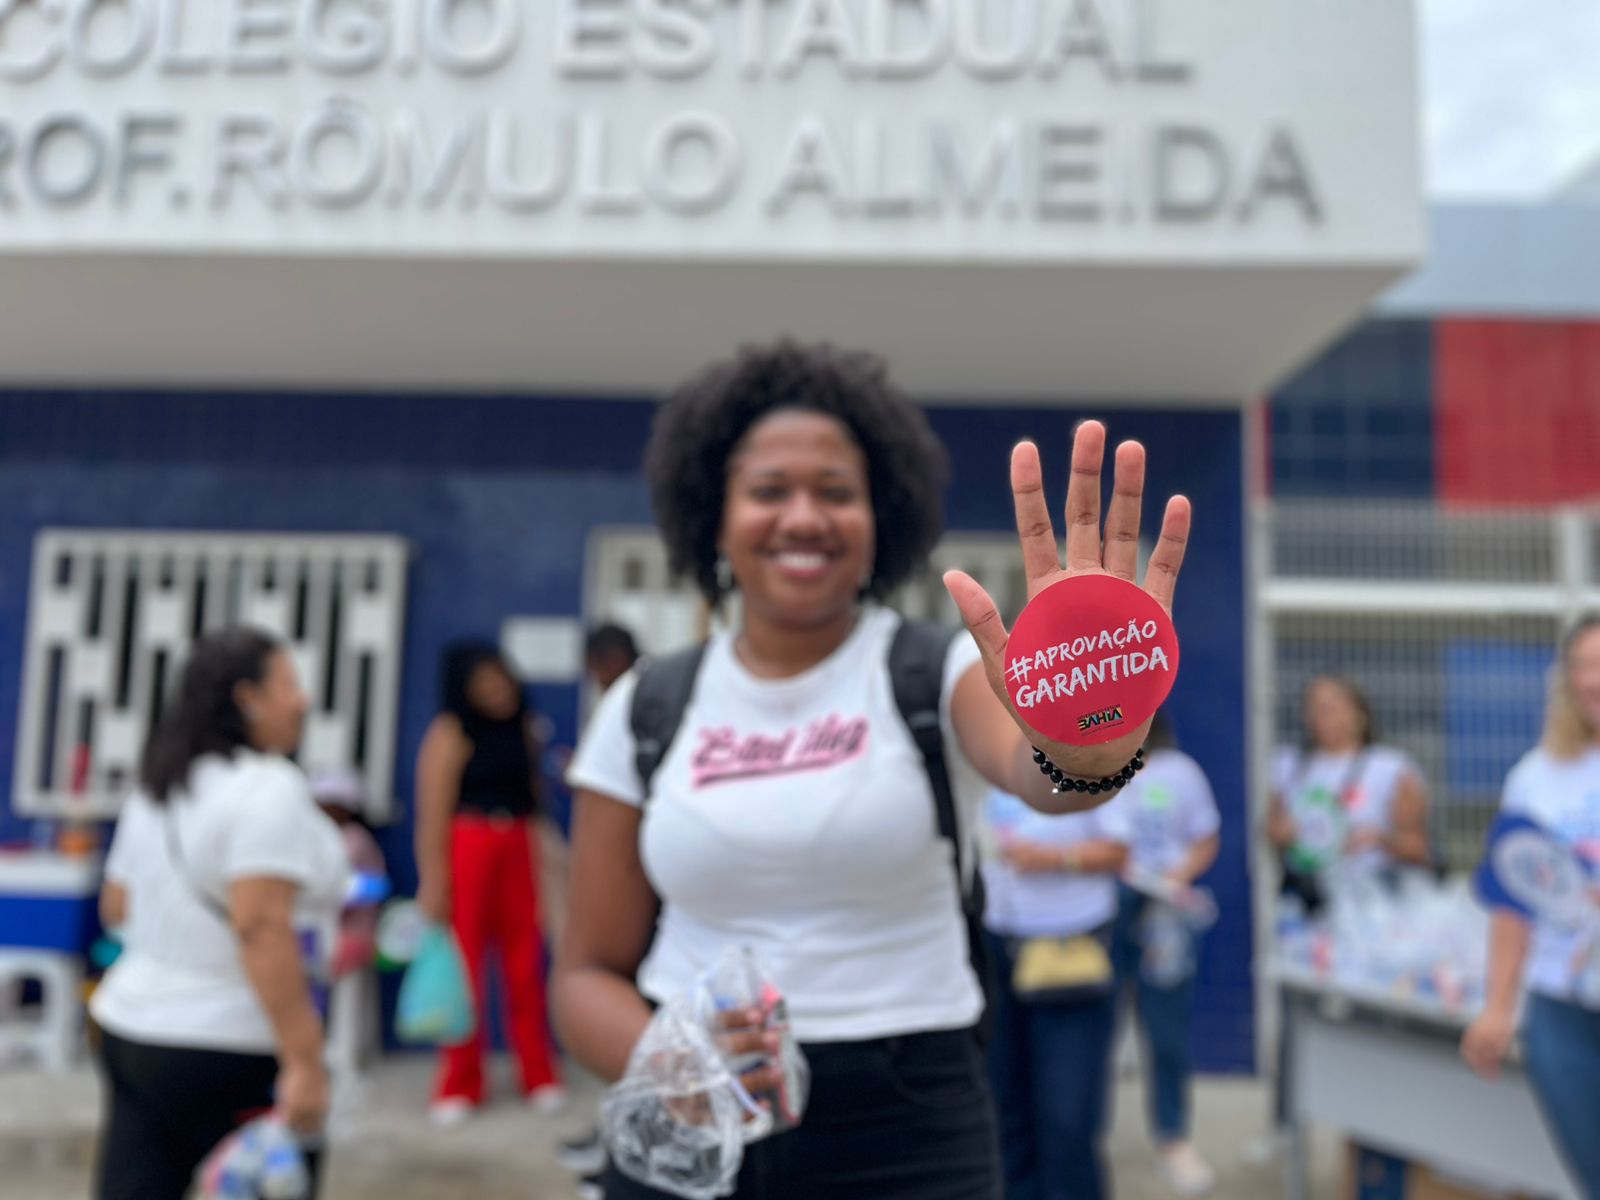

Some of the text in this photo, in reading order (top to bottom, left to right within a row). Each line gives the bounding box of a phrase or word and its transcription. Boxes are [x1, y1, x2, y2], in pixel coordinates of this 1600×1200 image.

[552, 0, 1197, 84] ESTADUAL
[0, 95, 1328, 228] OF. RÔMULO ALMEIDA
[1004, 618, 1158, 684] #APROVAÇÃO
[1015, 646, 1169, 709] GARANTIDA
